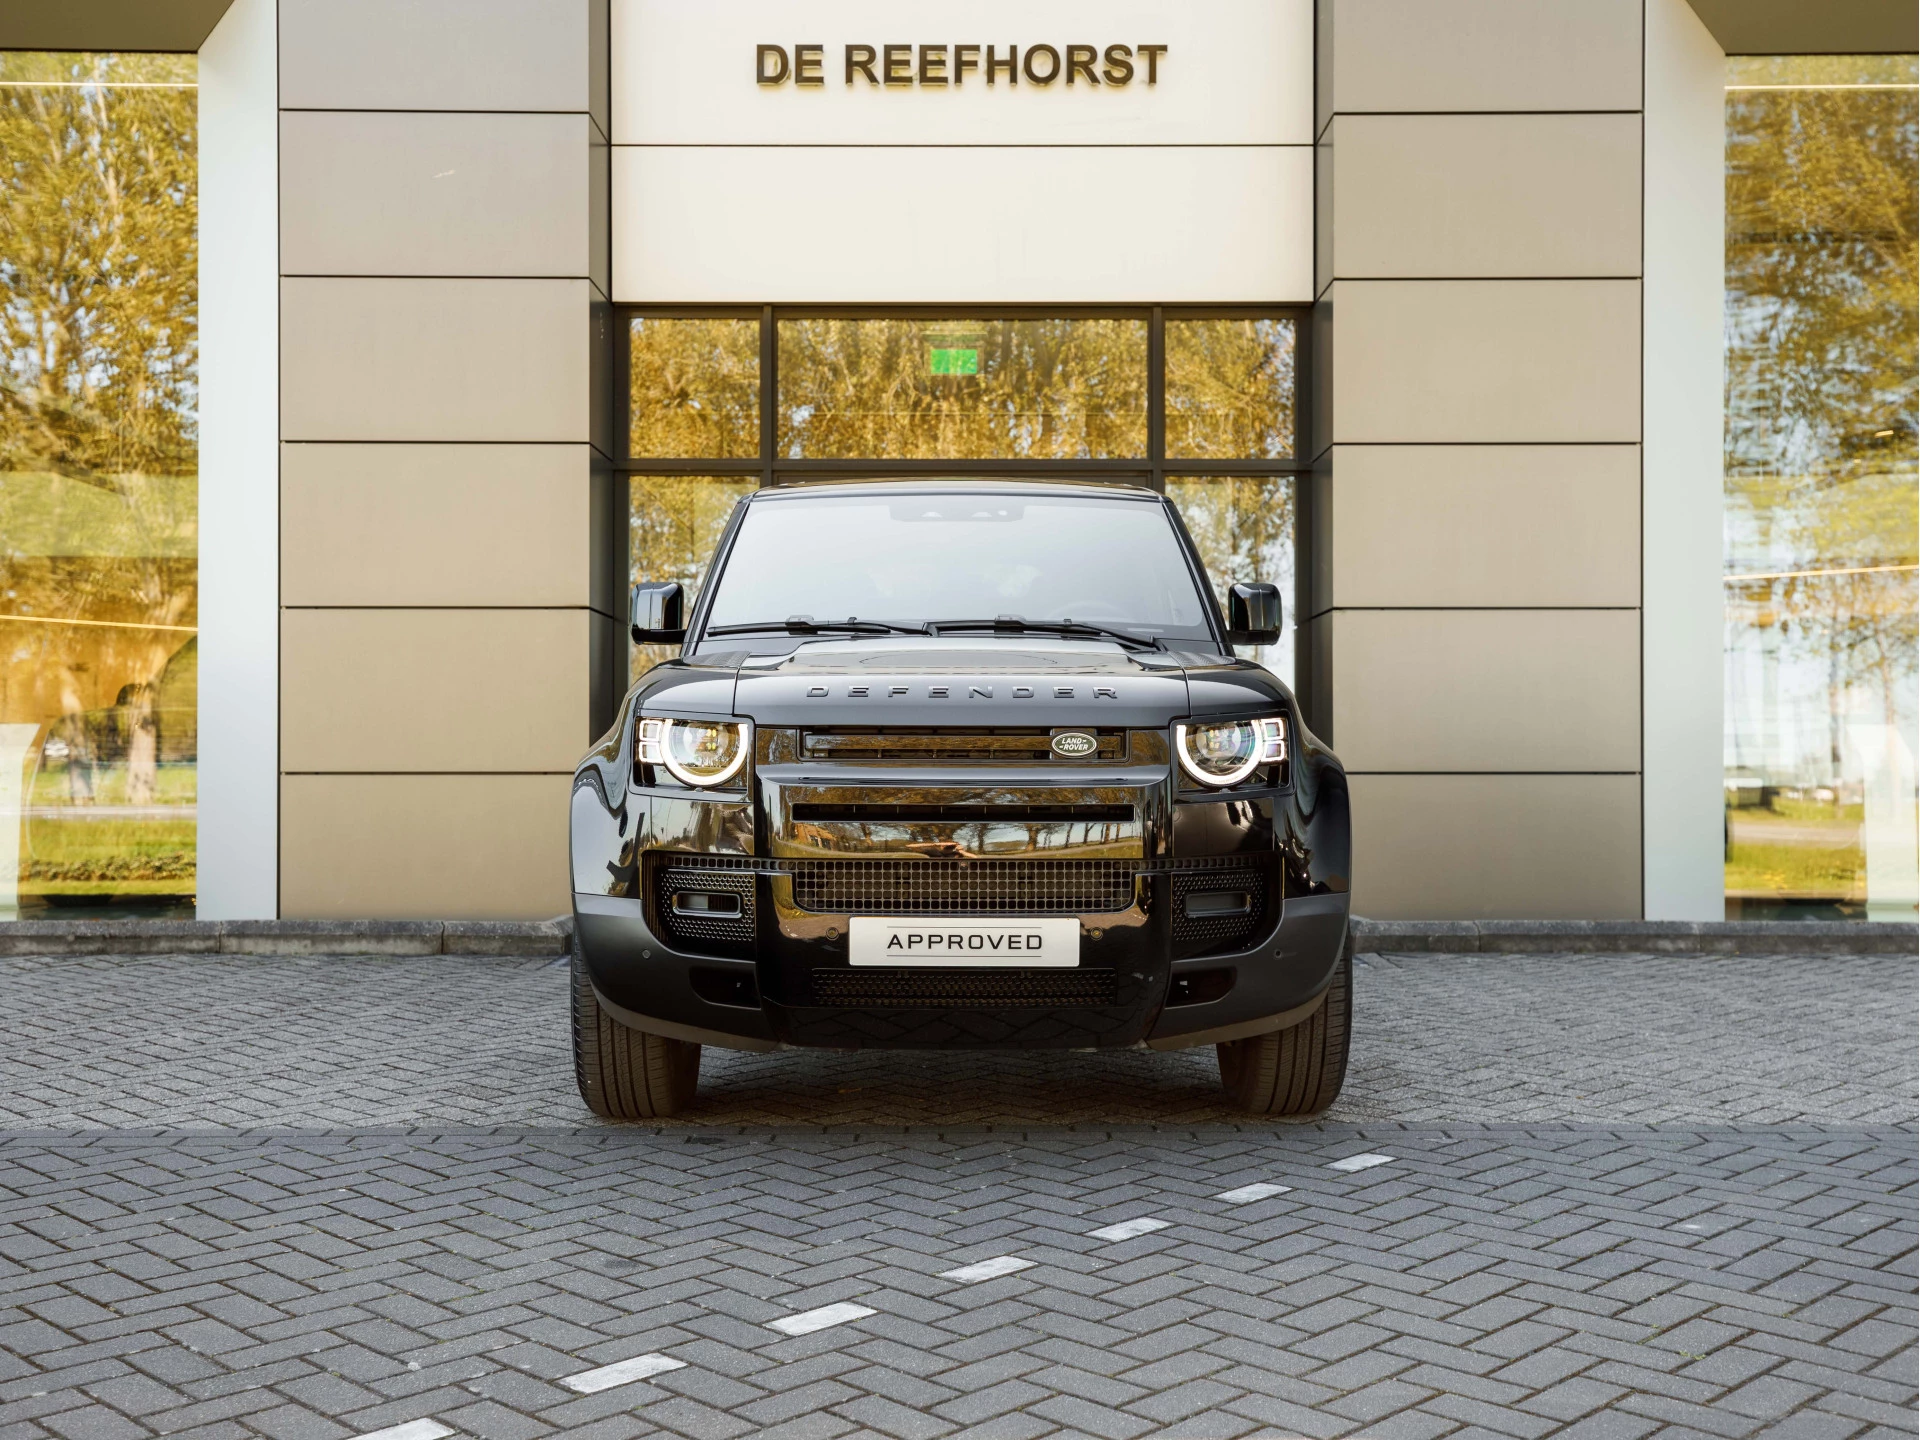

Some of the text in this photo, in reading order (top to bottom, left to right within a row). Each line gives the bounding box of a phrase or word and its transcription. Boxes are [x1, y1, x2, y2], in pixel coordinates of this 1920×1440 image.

[756, 44, 1168, 85] DE REEFHORST
[806, 685, 1118, 699] DEFENDER
[887, 934, 1043, 950] APPROVED
